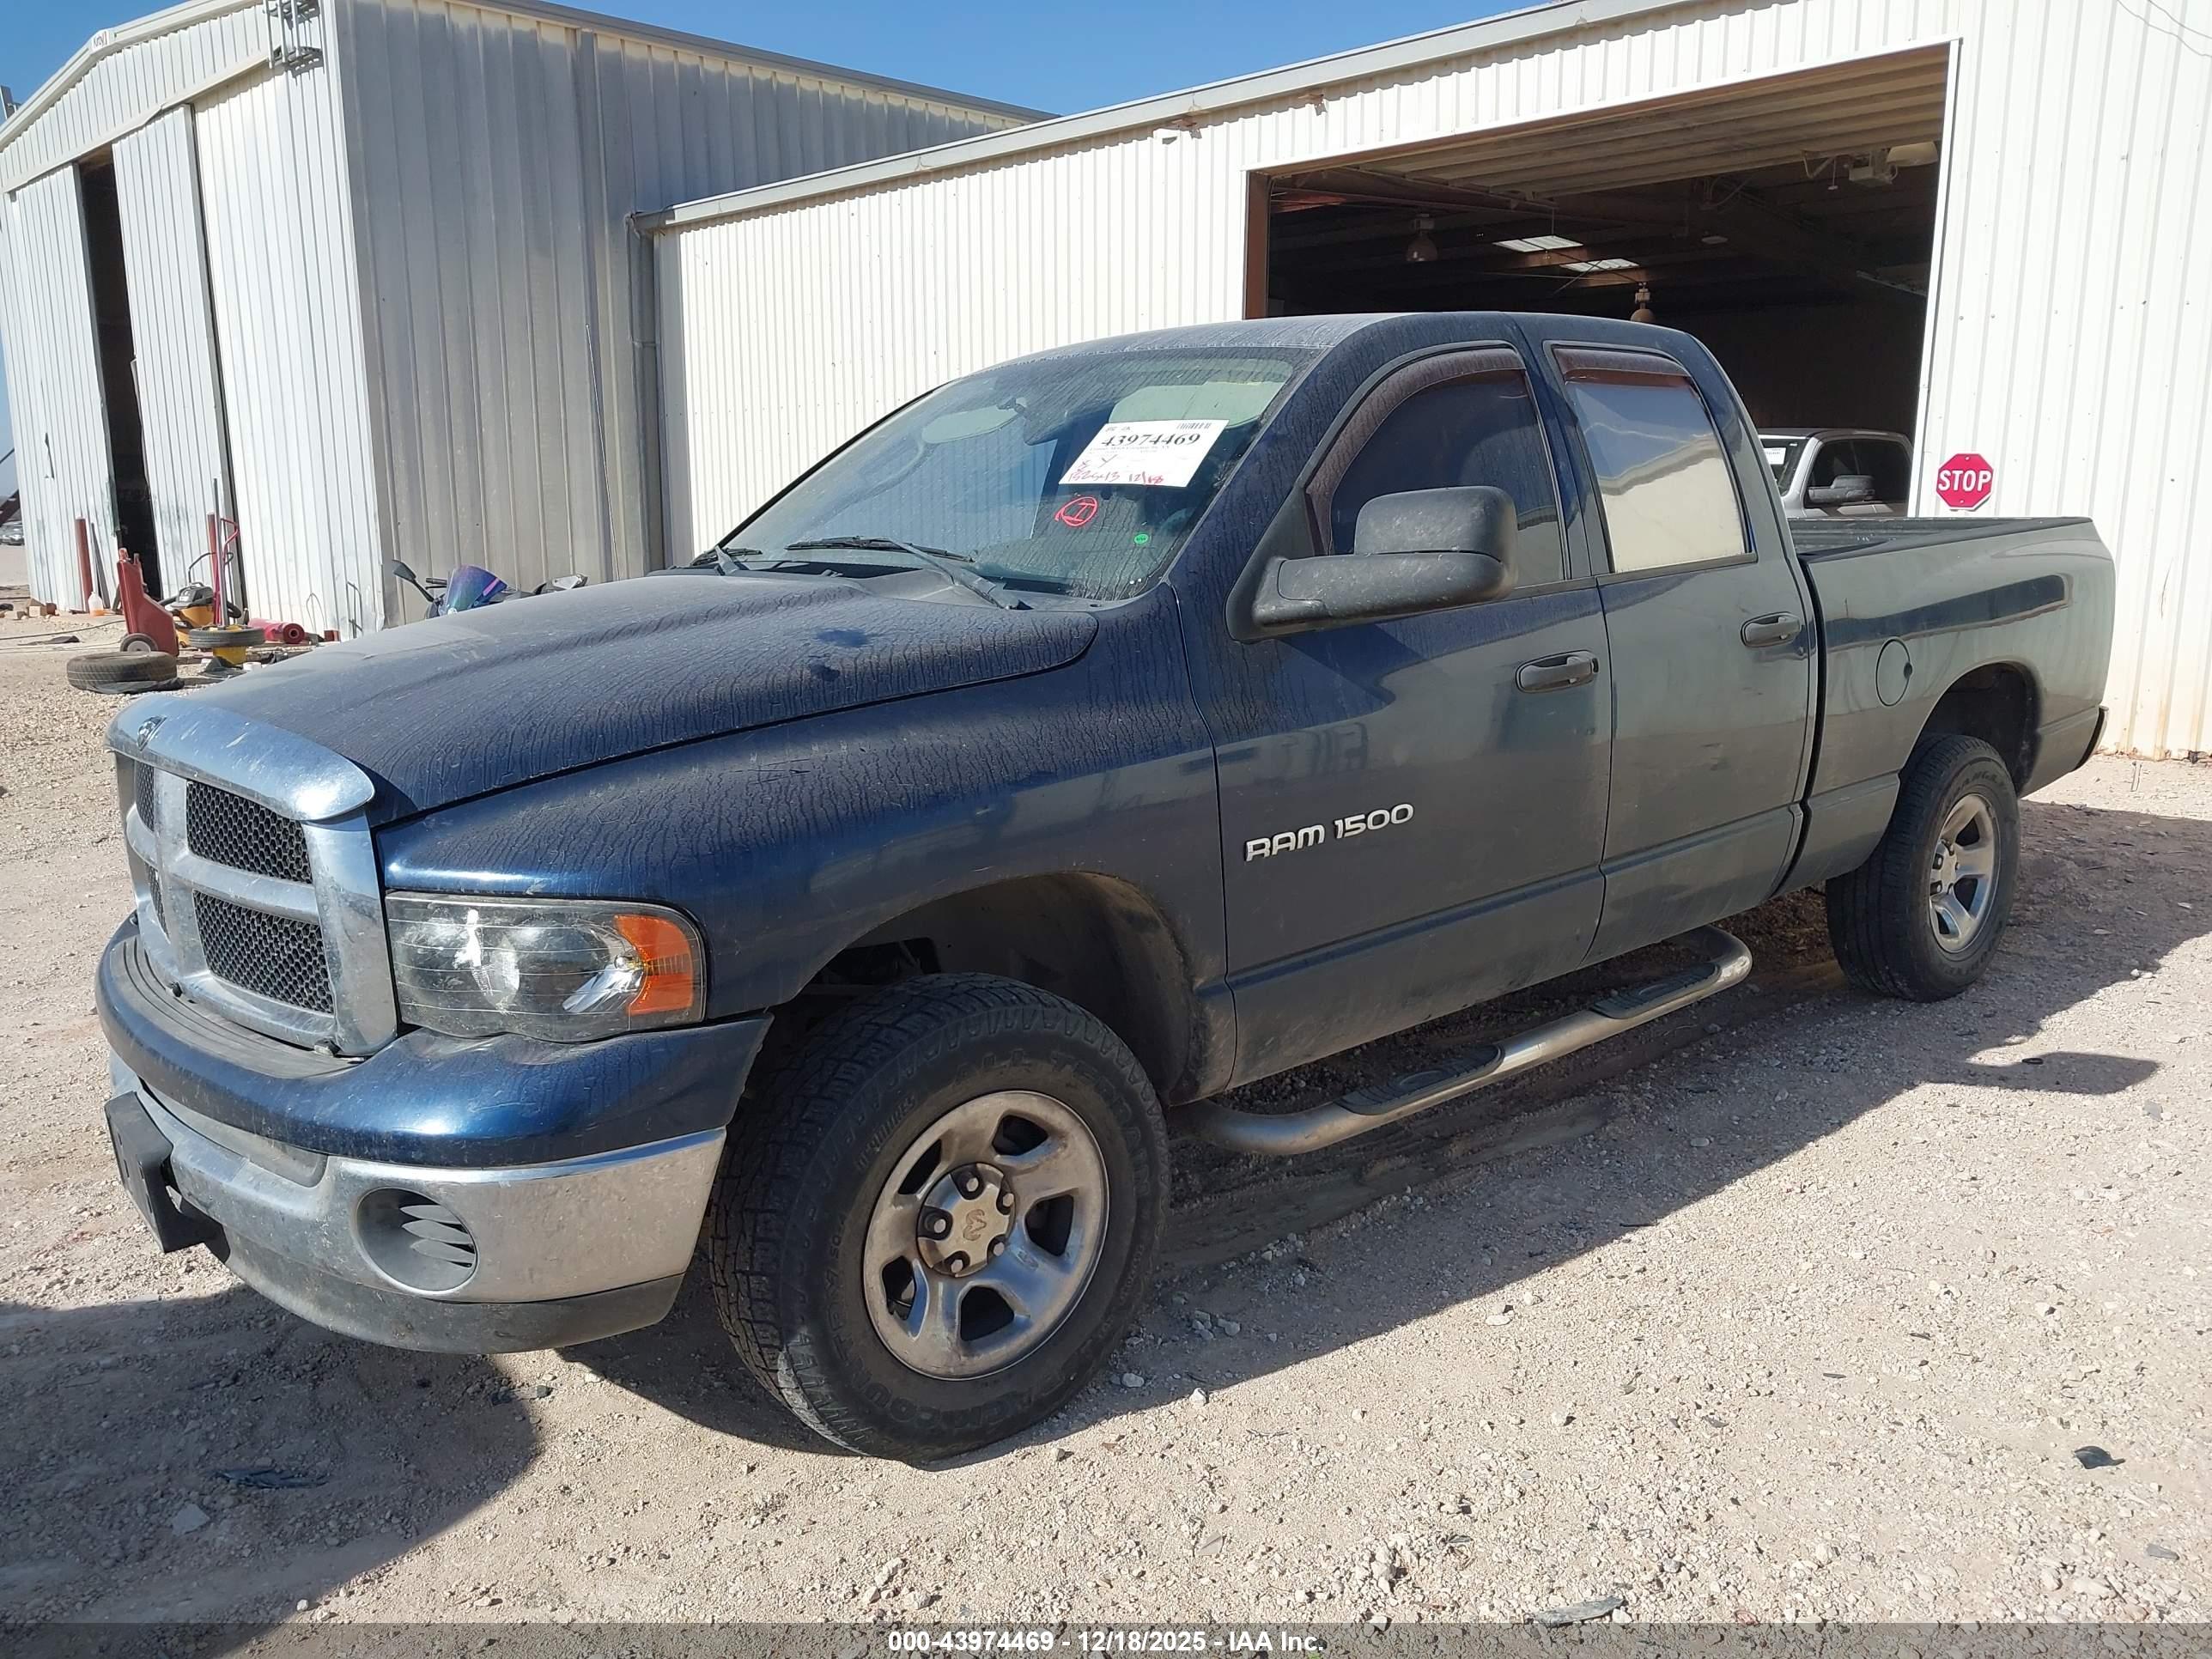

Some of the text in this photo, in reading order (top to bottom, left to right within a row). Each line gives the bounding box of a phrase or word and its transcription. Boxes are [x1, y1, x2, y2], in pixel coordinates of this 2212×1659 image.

[1101, 433, 1200, 447] 43974469
[1938, 469, 1991, 492] STOP
[1245, 804, 1414, 862] RAM 1500
